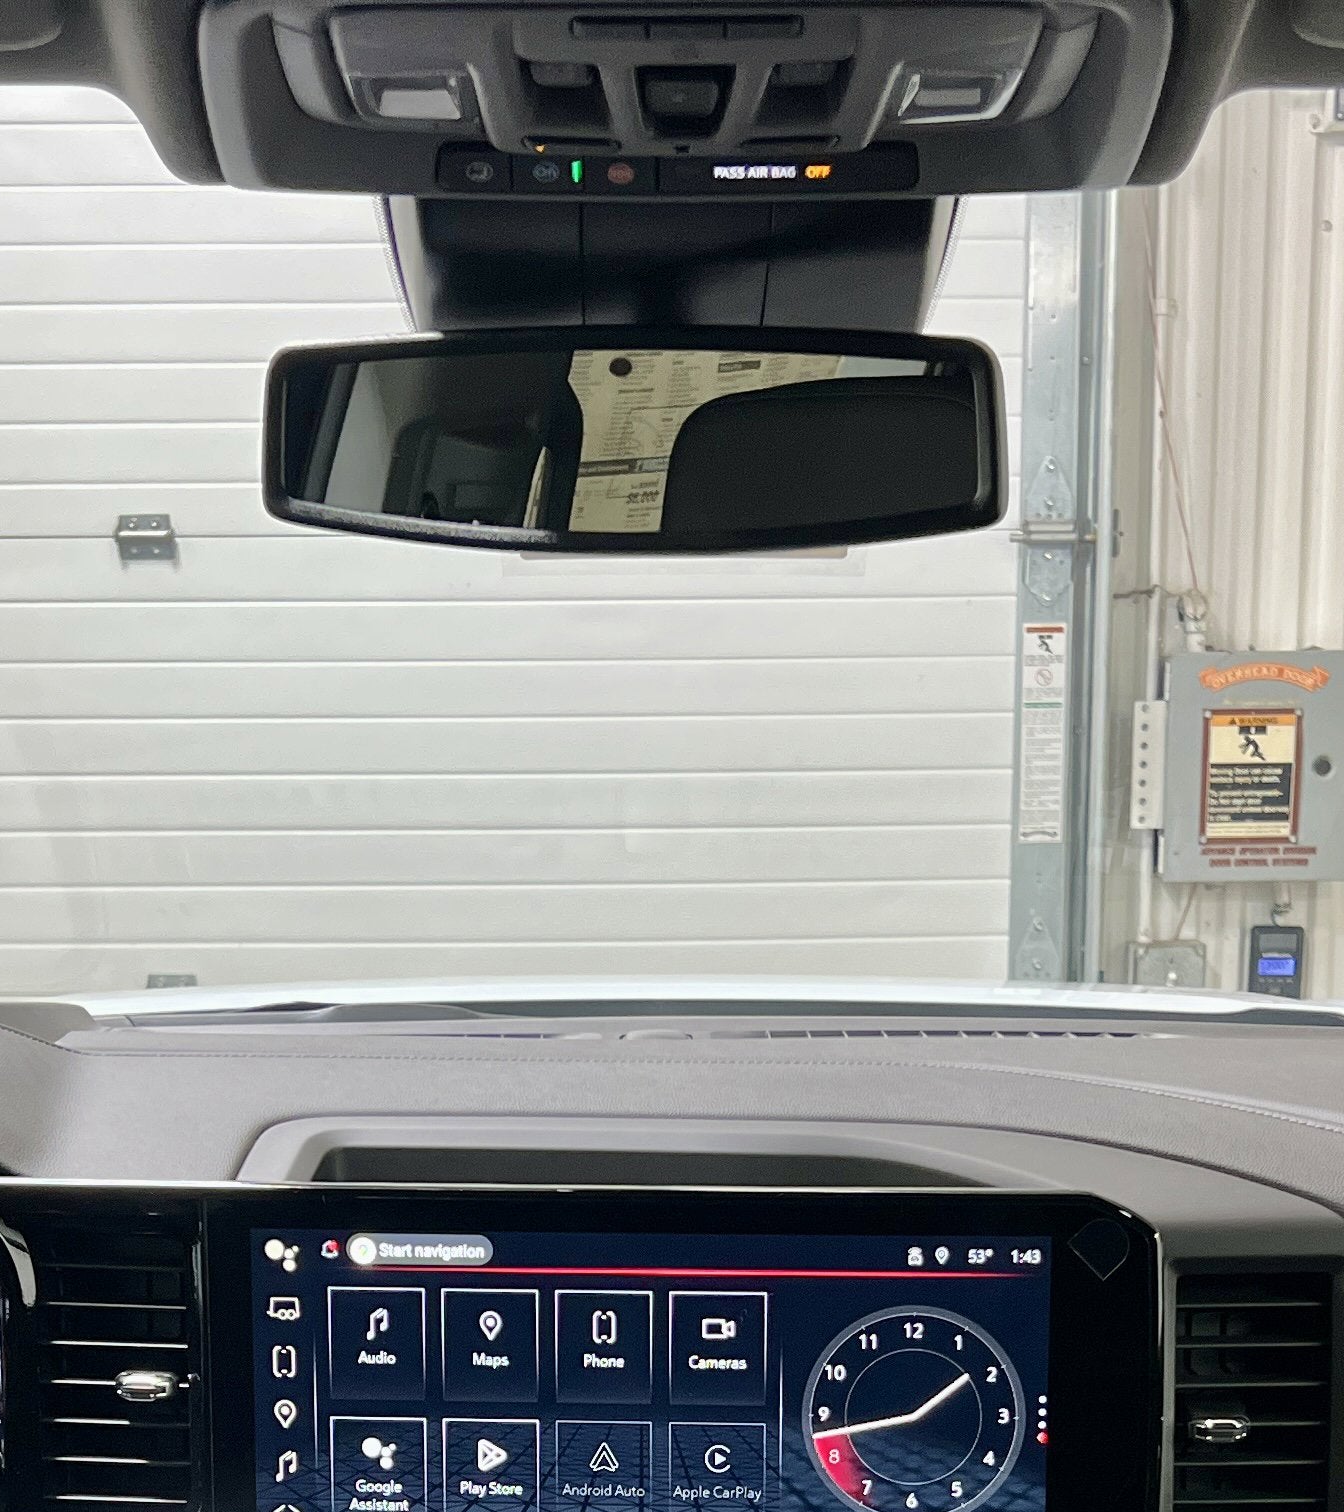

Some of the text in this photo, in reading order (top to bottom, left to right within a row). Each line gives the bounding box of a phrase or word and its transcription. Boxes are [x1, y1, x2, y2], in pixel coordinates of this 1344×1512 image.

[713, 165, 832, 179] PASS AIR BAG OFF
[379, 1242, 485, 1260] Start navigation
[1011, 1249, 1042, 1264] 1:43
[903, 1323, 924, 1338] 12
[859, 1334, 878, 1349] 11
[954, 1335, 963, 1350] 1
[358, 1351, 396, 1365] Audio
[472, 1353, 509, 1369] Maps
[583, 1354, 625, 1369] Phone
[688, 1355, 747, 1370] Cameras
[825, 1365, 847, 1381] 10
[986, 1367, 998, 1382] 2
[818, 1406, 830, 1421] 9
[998, 1408, 1009, 1424] 3
[828, 1449, 840, 1463] 8
[983, 1451, 995, 1466] 4
[356, 1479, 402, 1495] Google
[460, 1480, 523, 1496] Play Store
[562, 1483, 645, 1498] Android Auto
[673, 1485, 761, 1501] Apple CarPlay
[861, 1479, 872, 1495] 7
[951, 1482, 963, 1497] 5
[350, 1497, 409, 1512] Assistant
[906, 1493, 918, 1508] 6
